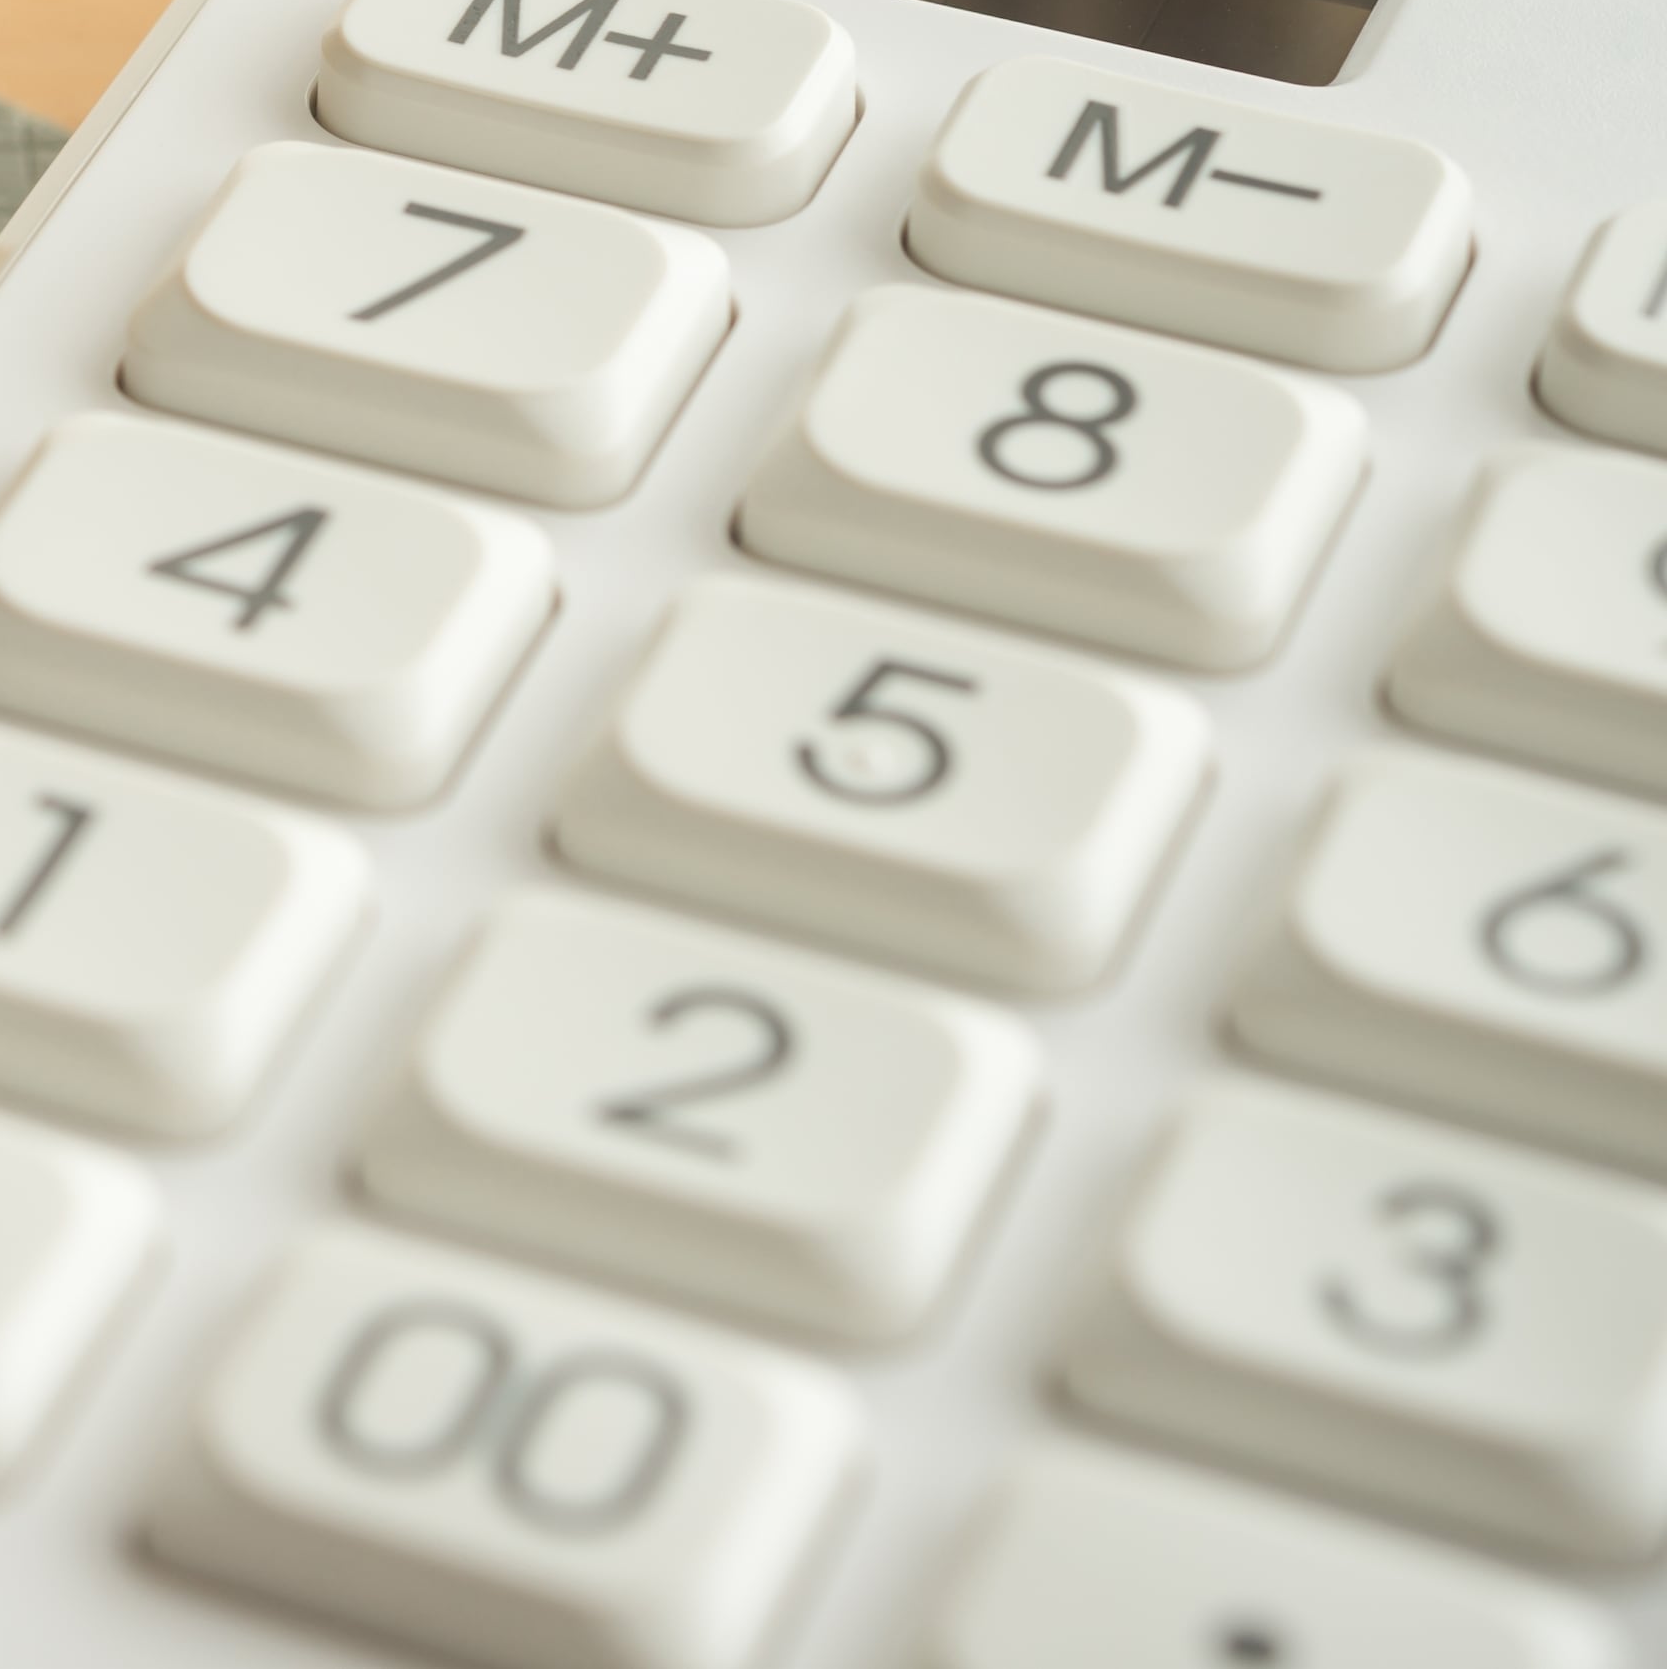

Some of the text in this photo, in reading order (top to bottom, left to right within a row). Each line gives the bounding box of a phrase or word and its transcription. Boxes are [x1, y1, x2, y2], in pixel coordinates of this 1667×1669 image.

[1046, 98, 1324, 211] M-
[350, 200, 528, 324] 7
[974, 357, 1142, 494] 8
[147, 504, 332, 634] 4
[792, 655, 979, 807] 5
[1475, 843, 1653, 999] 6
[592, 983, 800, 1163] 2
[1315, 1176, 1509, 1363] 3
[312, 1293, 692, 1537] 00
